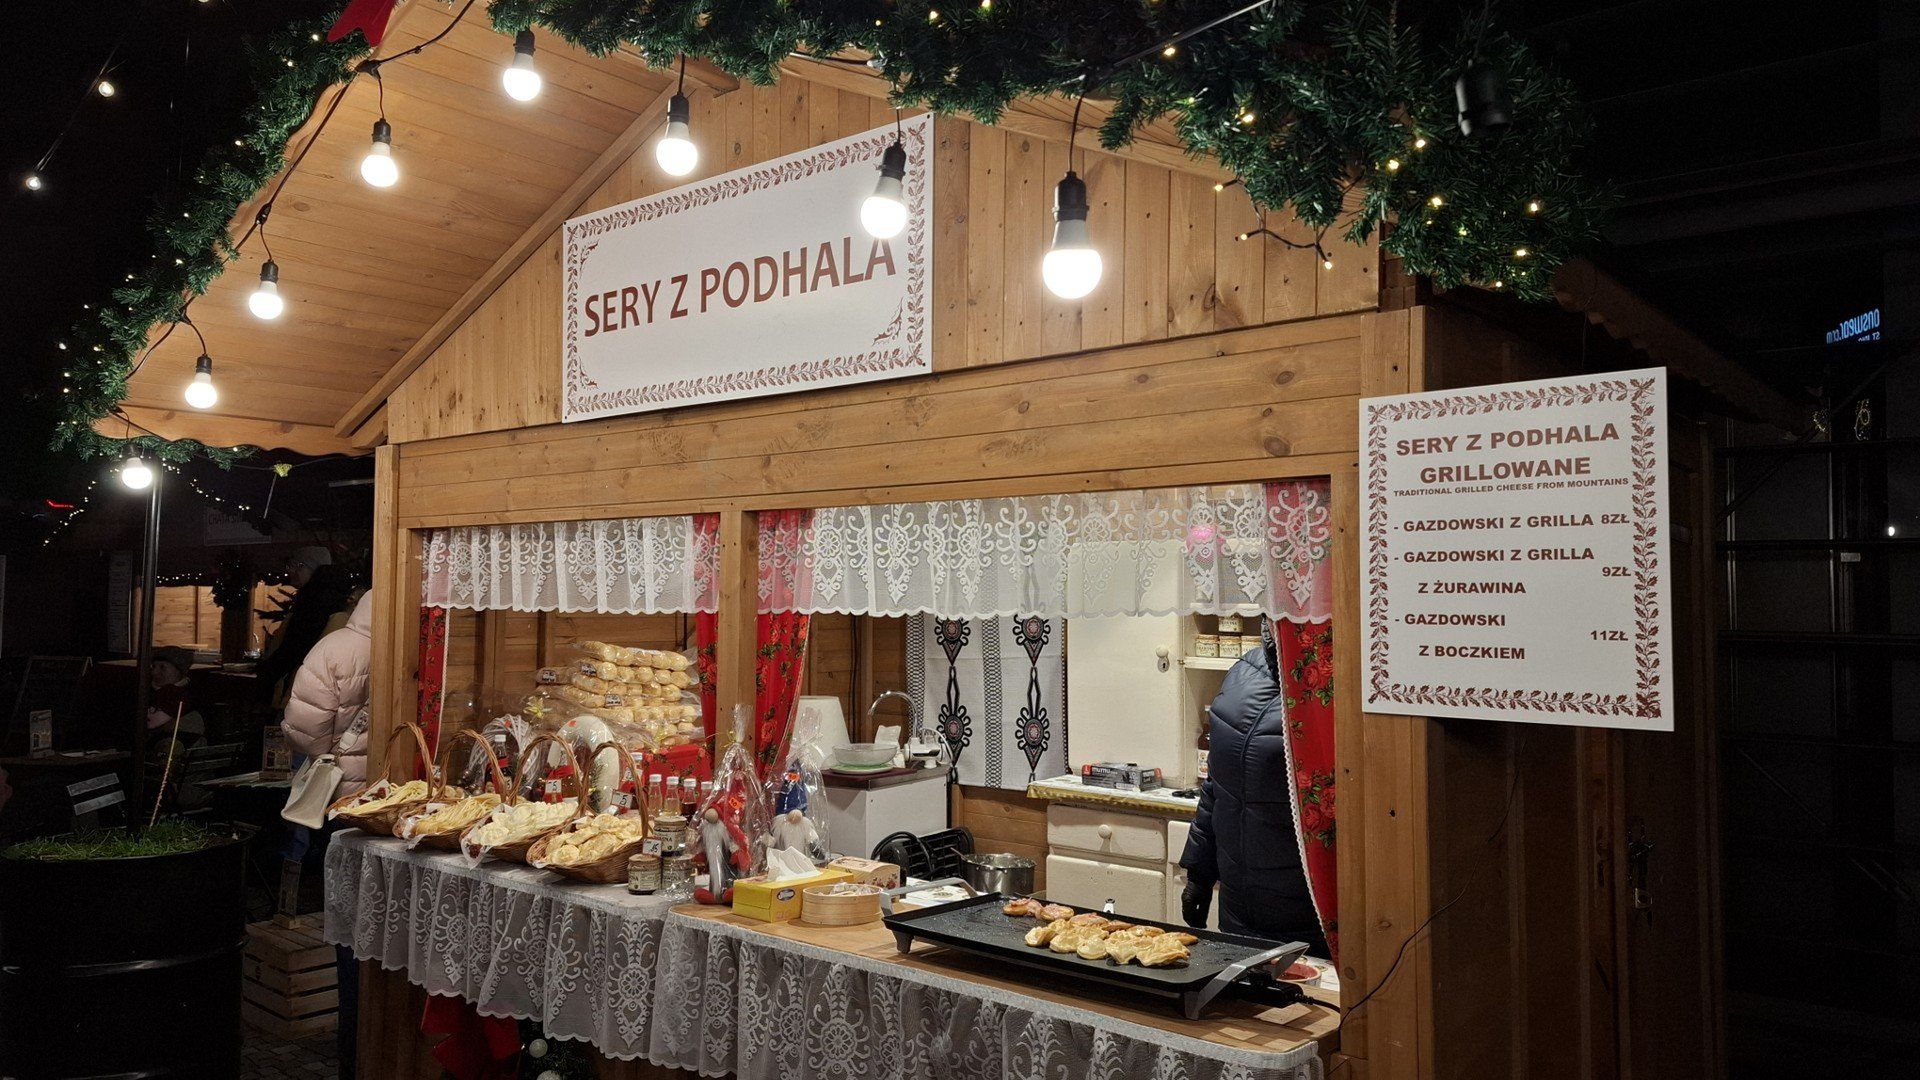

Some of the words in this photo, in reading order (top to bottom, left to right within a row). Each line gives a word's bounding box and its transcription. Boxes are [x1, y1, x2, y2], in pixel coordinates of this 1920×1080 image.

[584, 280, 661, 337] SERY
[669, 274, 689, 319] Z
[700, 236, 896, 313] PODHALA
[1397, 436, 1458, 456] SERY
[1465, 433, 1483, 451] Z
[1491, 423, 1619, 449] PODHALA
[1421, 457, 1591, 483] GRILLOWANE
[1393, 487, 1453, 497] TRADITIONAL
[1454, 485, 1494, 494] GRILLED
[1495, 482, 1534, 492] CHEESE
[1536, 481, 1565, 490] FROM
[1567, 477, 1629, 488] MOUNTAINS
[1403, 517, 1504, 533] GAZDOWSKI
[1509, 516, 1522, 529] Z
[1526, 513, 1595, 528] GRILLA
[1600, 513, 1631, 525] 8ZŁ
[1403, 549, 1505, 564] GAZDOWSKI
[1510, 549, 1522, 562] Z
[1526, 547, 1595, 561] GRILLA
[1601, 566, 1632, 578] 9ZŁ
[1417, 582, 1429, 594] Z
[1432, 579, 1527, 594] ŻURAWINA
[1404, 613, 1506, 627] GAZDOWSKI
[1590, 629, 1629, 642] 11ZŁ
[1418, 644, 1430, 657] Z
[1434, 645, 1526, 660] BOCZKIEM
